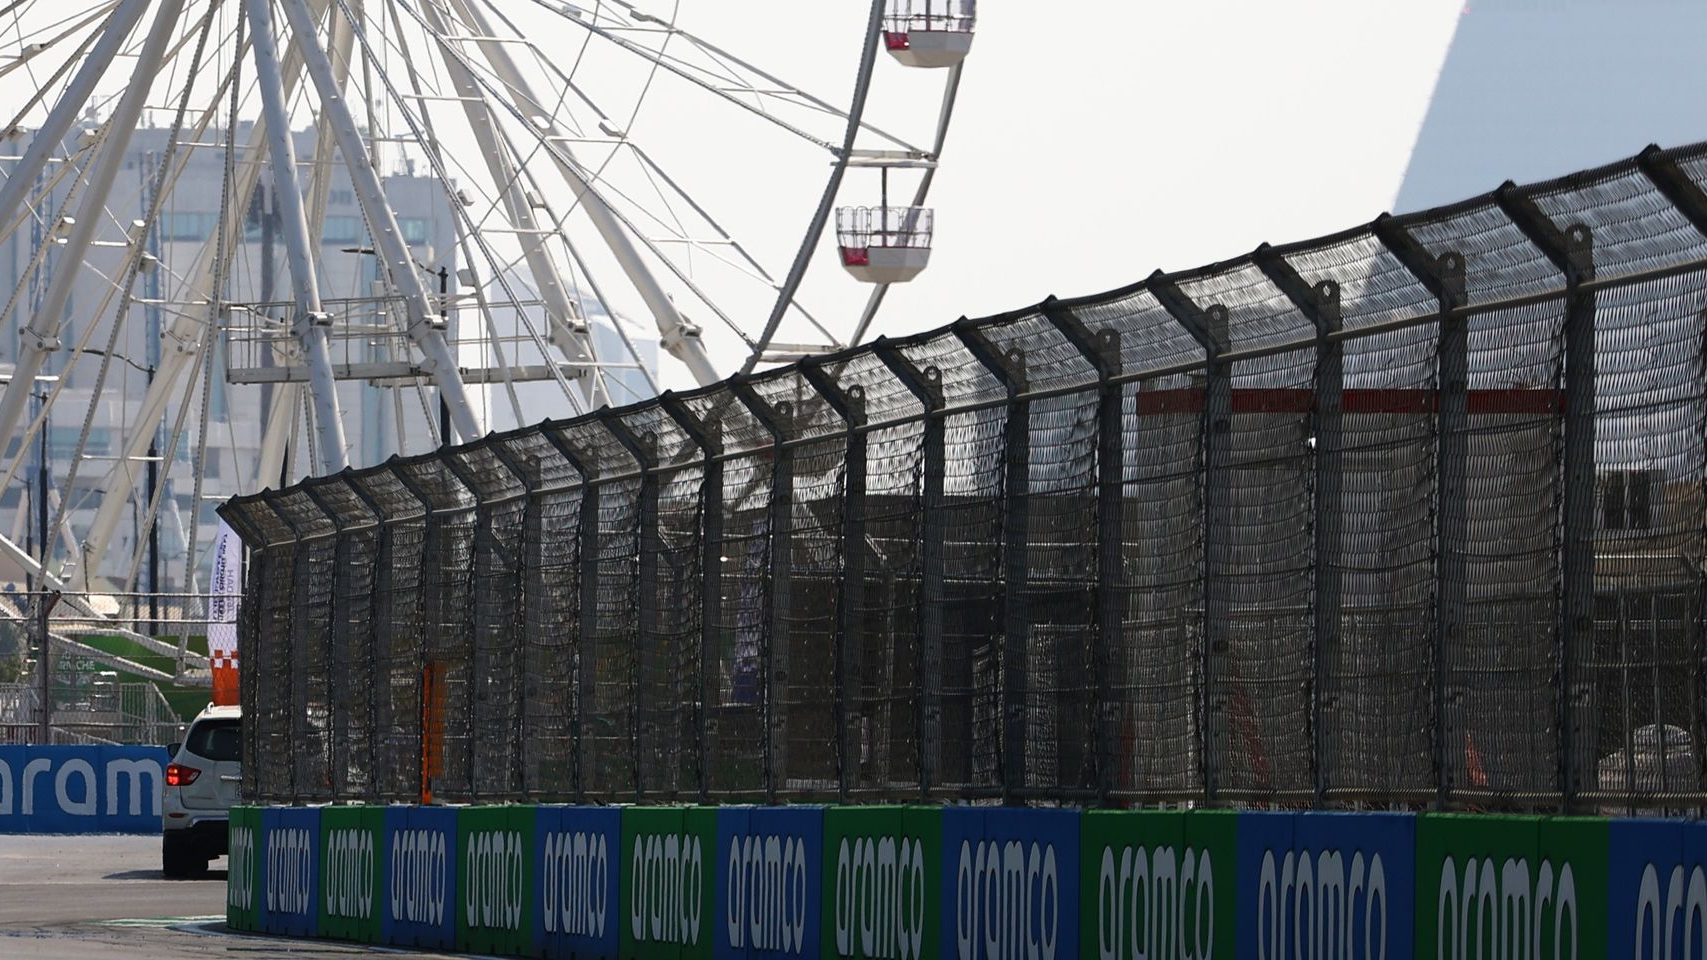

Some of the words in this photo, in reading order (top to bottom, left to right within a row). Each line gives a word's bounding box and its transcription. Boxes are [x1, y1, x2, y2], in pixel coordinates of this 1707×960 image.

[267, 827, 310, 915] aramco
[327, 829, 373, 919] aramco
[391, 830, 446, 926] aramco
[467, 831, 522, 930] aramco
[544, 832, 607, 937] aramco
[632, 834, 701, 945] aramco
[728, 836, 806, 954] aramco
[836, 837, 924, 959] aramco
[958, 840, 1057, 960] aramco
[1099, 846, 1213, 960] aramco
[1259, 850, 1386, 960] aramco
